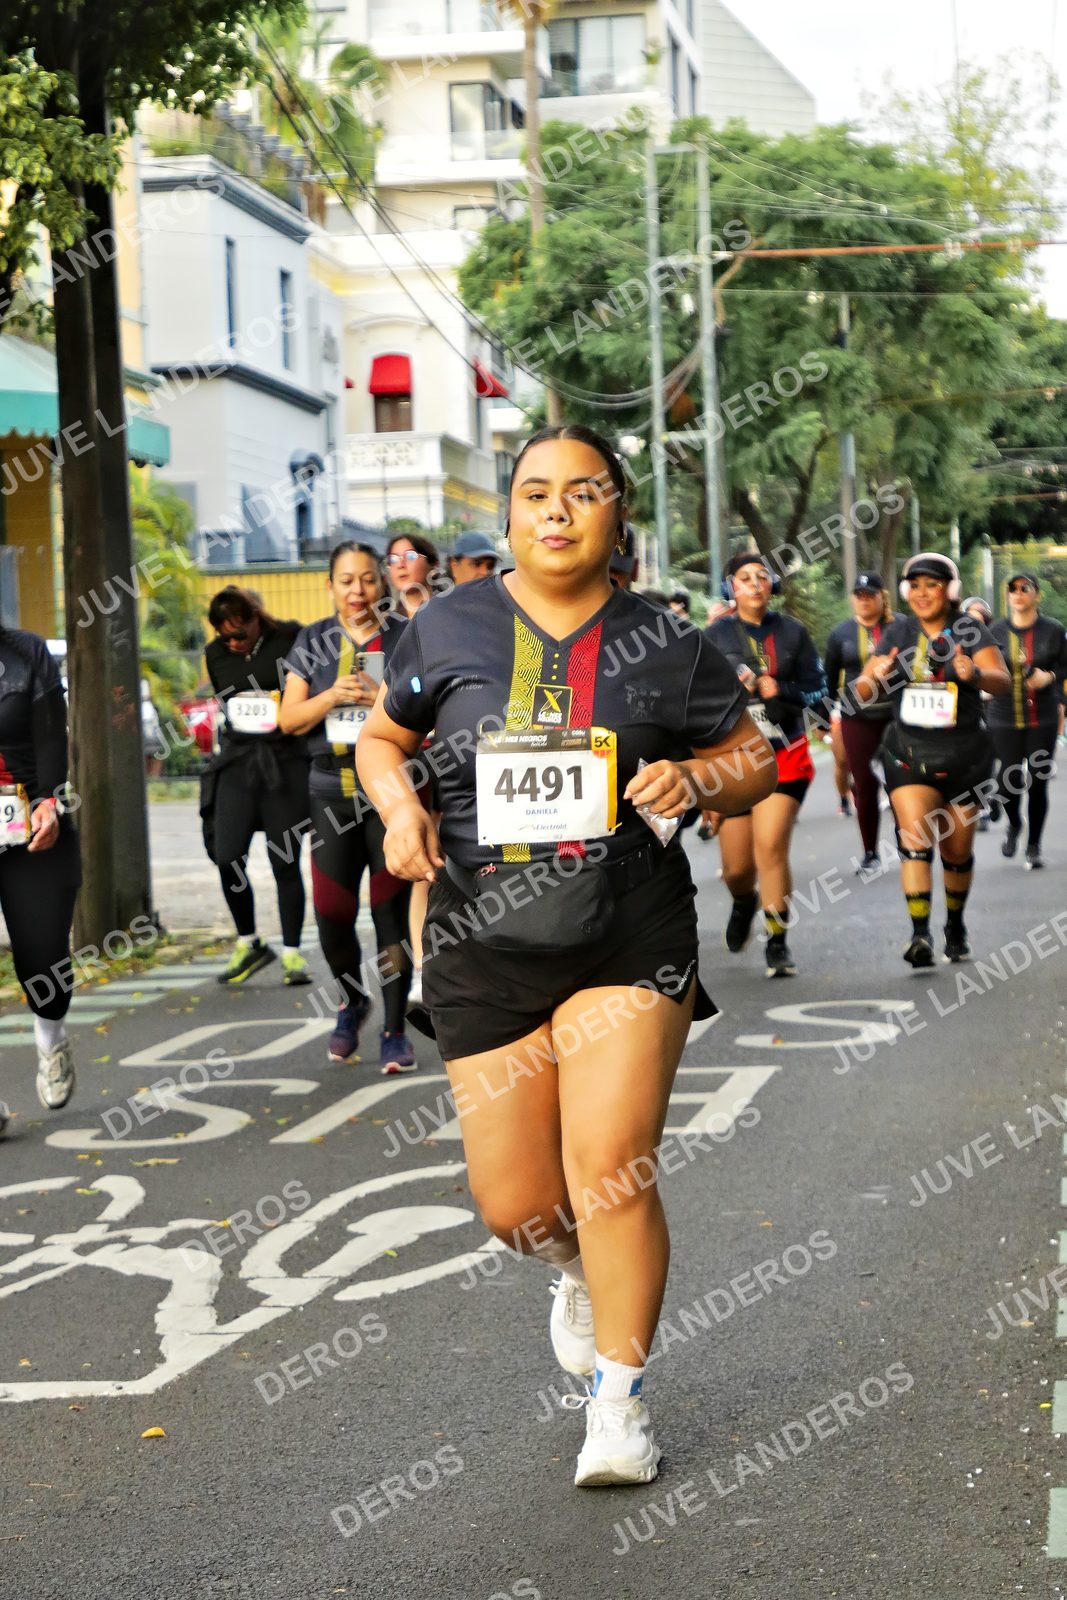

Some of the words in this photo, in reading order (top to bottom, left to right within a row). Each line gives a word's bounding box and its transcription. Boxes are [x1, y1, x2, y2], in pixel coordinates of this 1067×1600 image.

[911, 694, 945, 709] 1114
[236, 703, 268, 717] 3203
[335, 710, 367, 722] 449
[594, 735, 611, 748] 5K
[494, 765, 583, 803] 4491
[2, 804, 15, 823] 9
[525, 808, 559, 816] DANIELA
